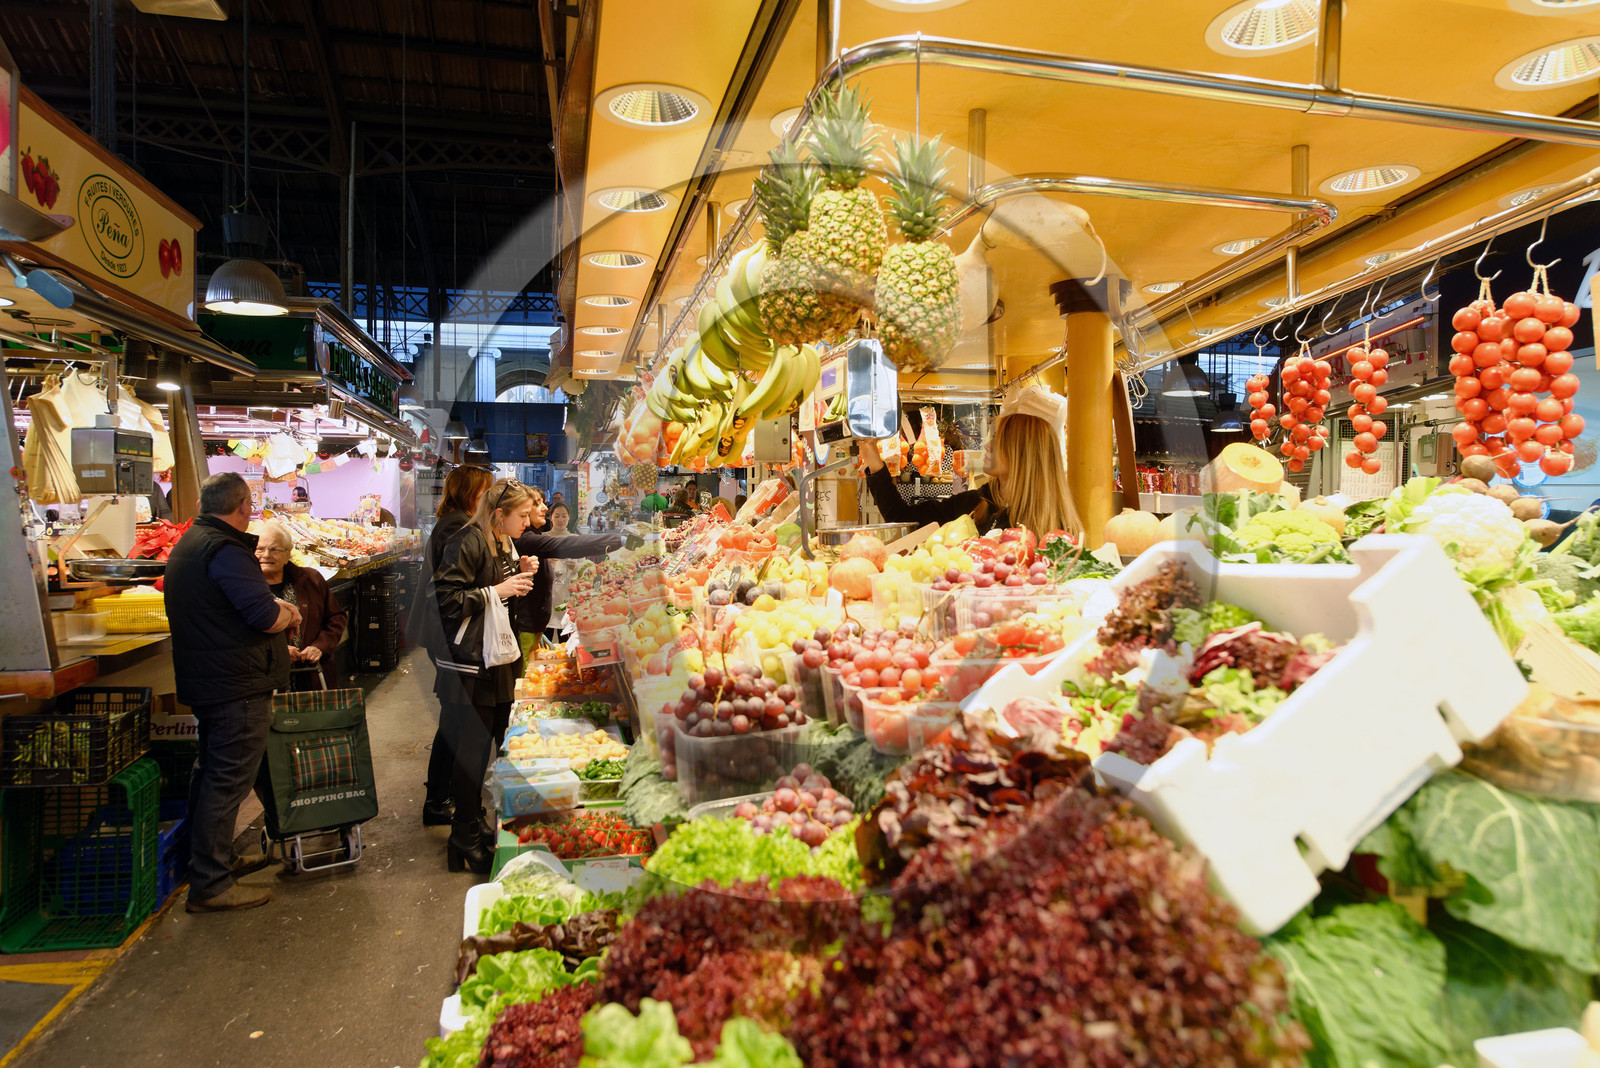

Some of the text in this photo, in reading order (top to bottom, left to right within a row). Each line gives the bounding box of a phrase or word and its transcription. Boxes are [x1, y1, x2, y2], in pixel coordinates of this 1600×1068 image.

[85, 182, 108, 208] FRUITES
[111, 187, 139, 237] VERDURES
[97, 208, 129, 248] Peña
[101, 250, 116, 271] Desde
[290, 789, 366, 808] SHOPPING BAG
